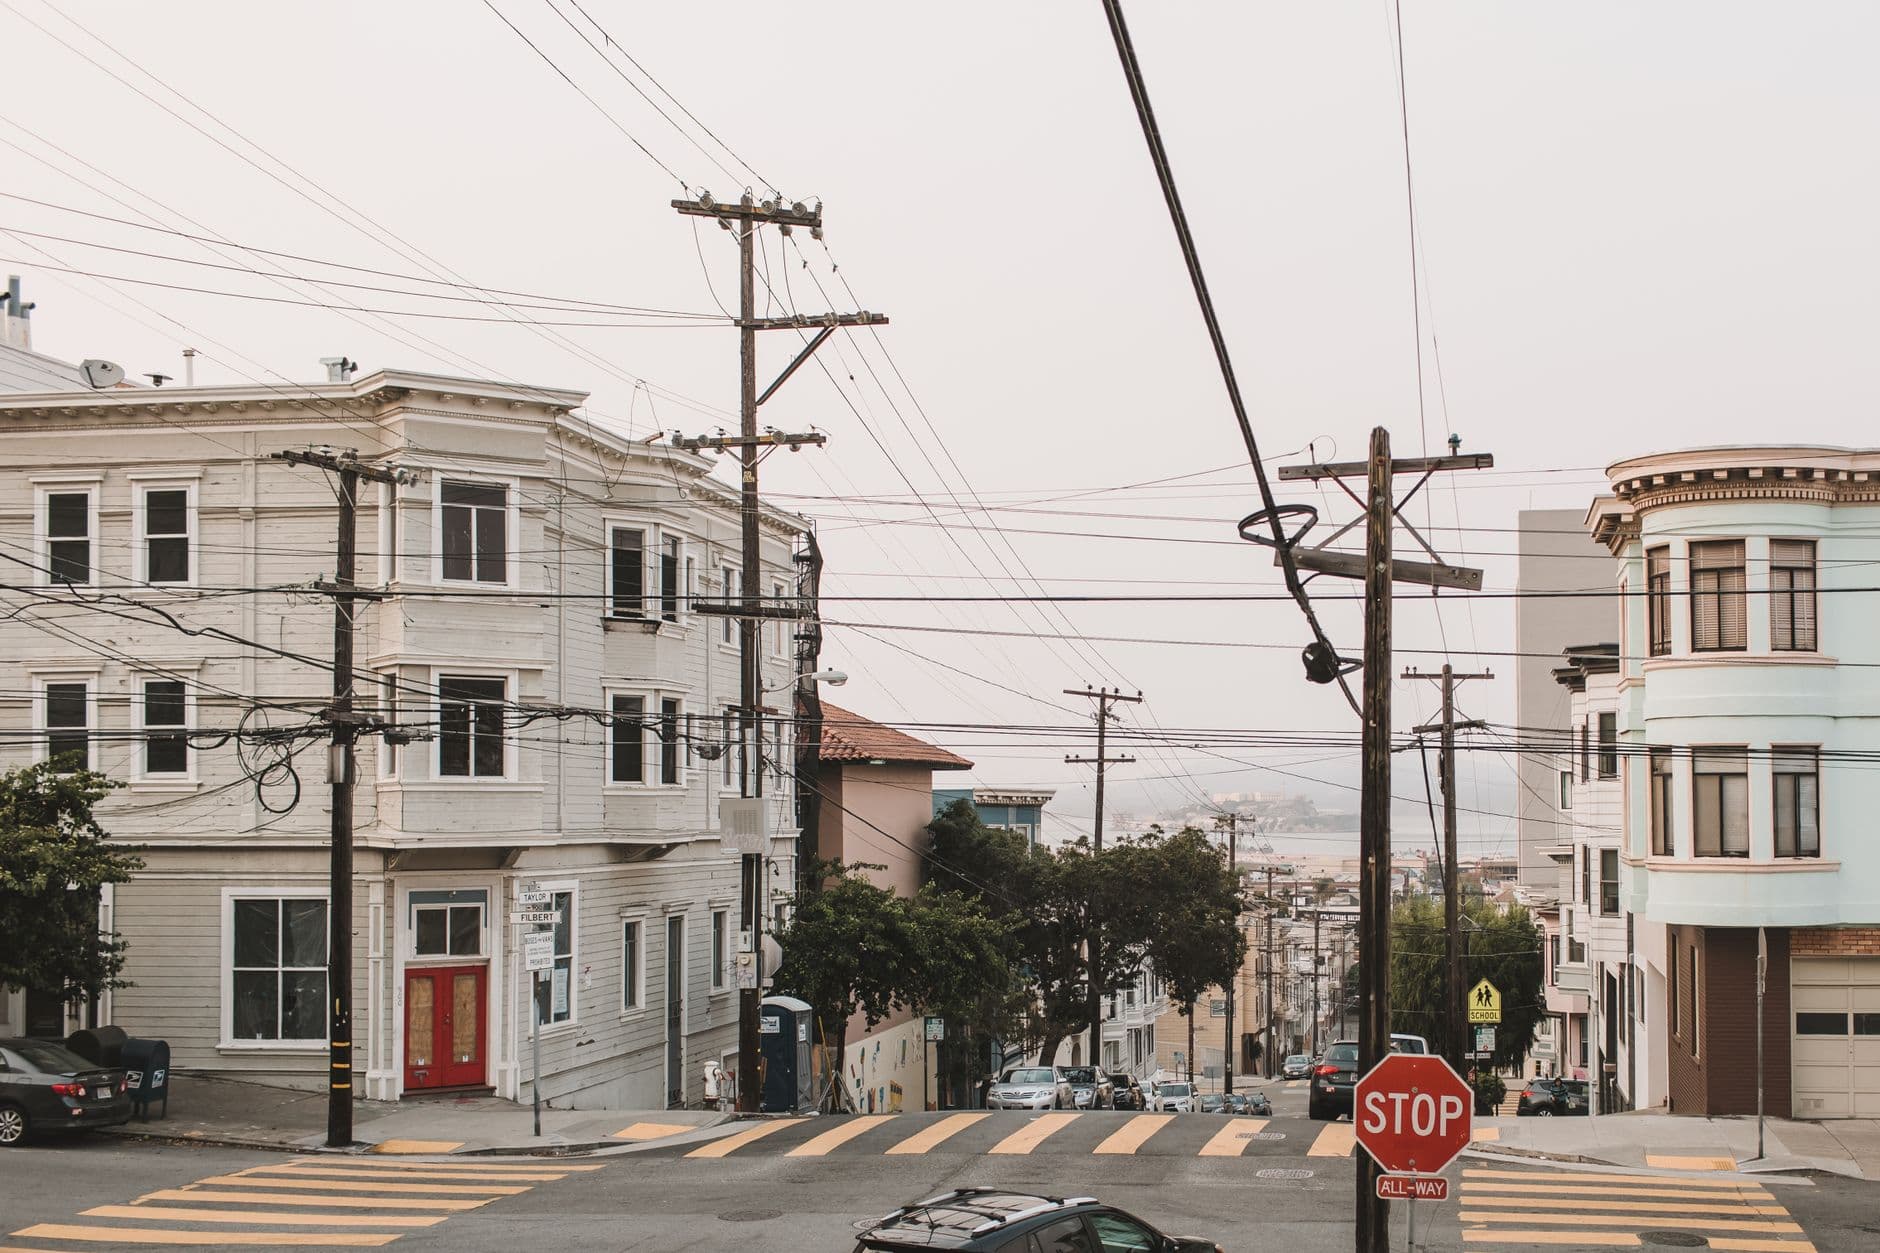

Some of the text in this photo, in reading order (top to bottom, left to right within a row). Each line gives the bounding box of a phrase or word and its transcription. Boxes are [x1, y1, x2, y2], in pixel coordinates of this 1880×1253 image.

[524, 893, 546, 901] TAYLOR
[520, 913, 554, 922] FILBERT
[1471, 1012, 1498, 1020] SCHOOL
[1363, 1091, 1463, 1137] STOP
[1380, 1180, 1445, 1196] ALL-WAY
